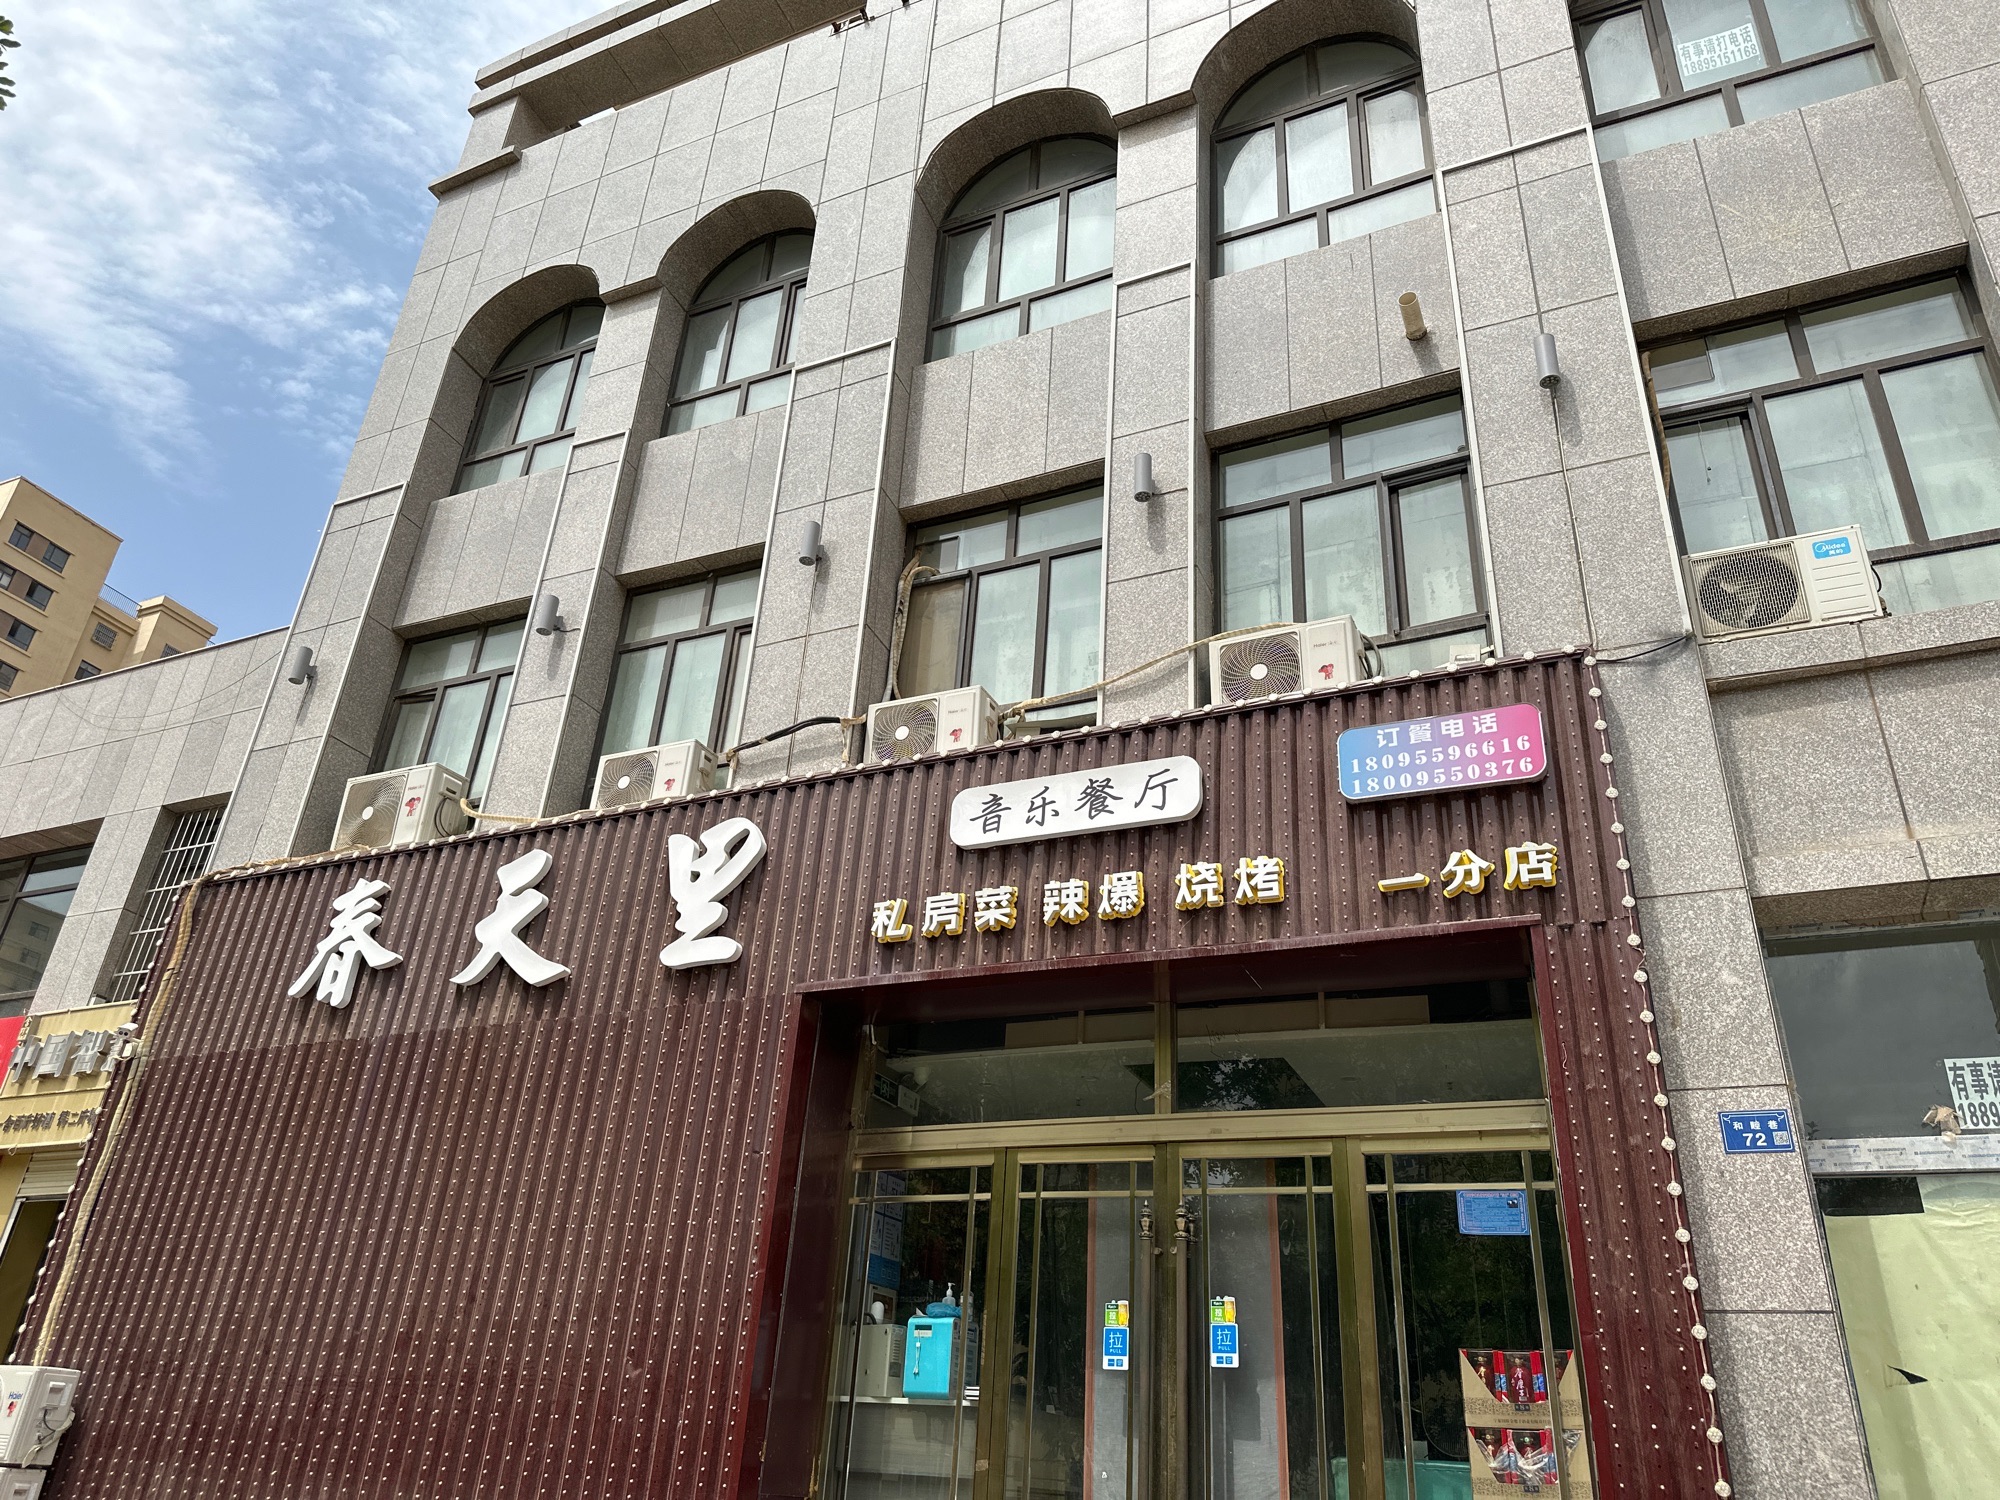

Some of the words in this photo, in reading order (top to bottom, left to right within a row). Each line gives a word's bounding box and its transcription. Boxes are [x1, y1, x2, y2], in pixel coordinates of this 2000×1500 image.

[1680, 26, 1753, 62] 有事请打电话
[1684, 44, 1758, 75] 18895151168
[1816, 542, 1846, 553] Midea
[1376, 713, 1498, 748] 订餐电话
[1351, 735, 1531, 774] 18095596616
[1352, 757, 1534, 795] 18009550376
[969, 768, 1178, 834] 音乐餐厅
[871, 885, 1019, 943] 私房菜
[1043, 870, 1145, 927] 辣爆
[1175, 856, 1285, 910] 烧烤
[1378, 841, 1558, 898] 一分店
[288, 816, 768, 1008] 春天里
[1948, 1060, 2000, 1100] 有事请
[1732, 1119, 1779, 1131] 和睦巷
[1742, 1133, 1768, 1147] 72
[1109, 1331, 1123, 1348] 拉
[1216, 1328, 1232, 1345] 拉
[8, 1391, 23, 1400] Haier
